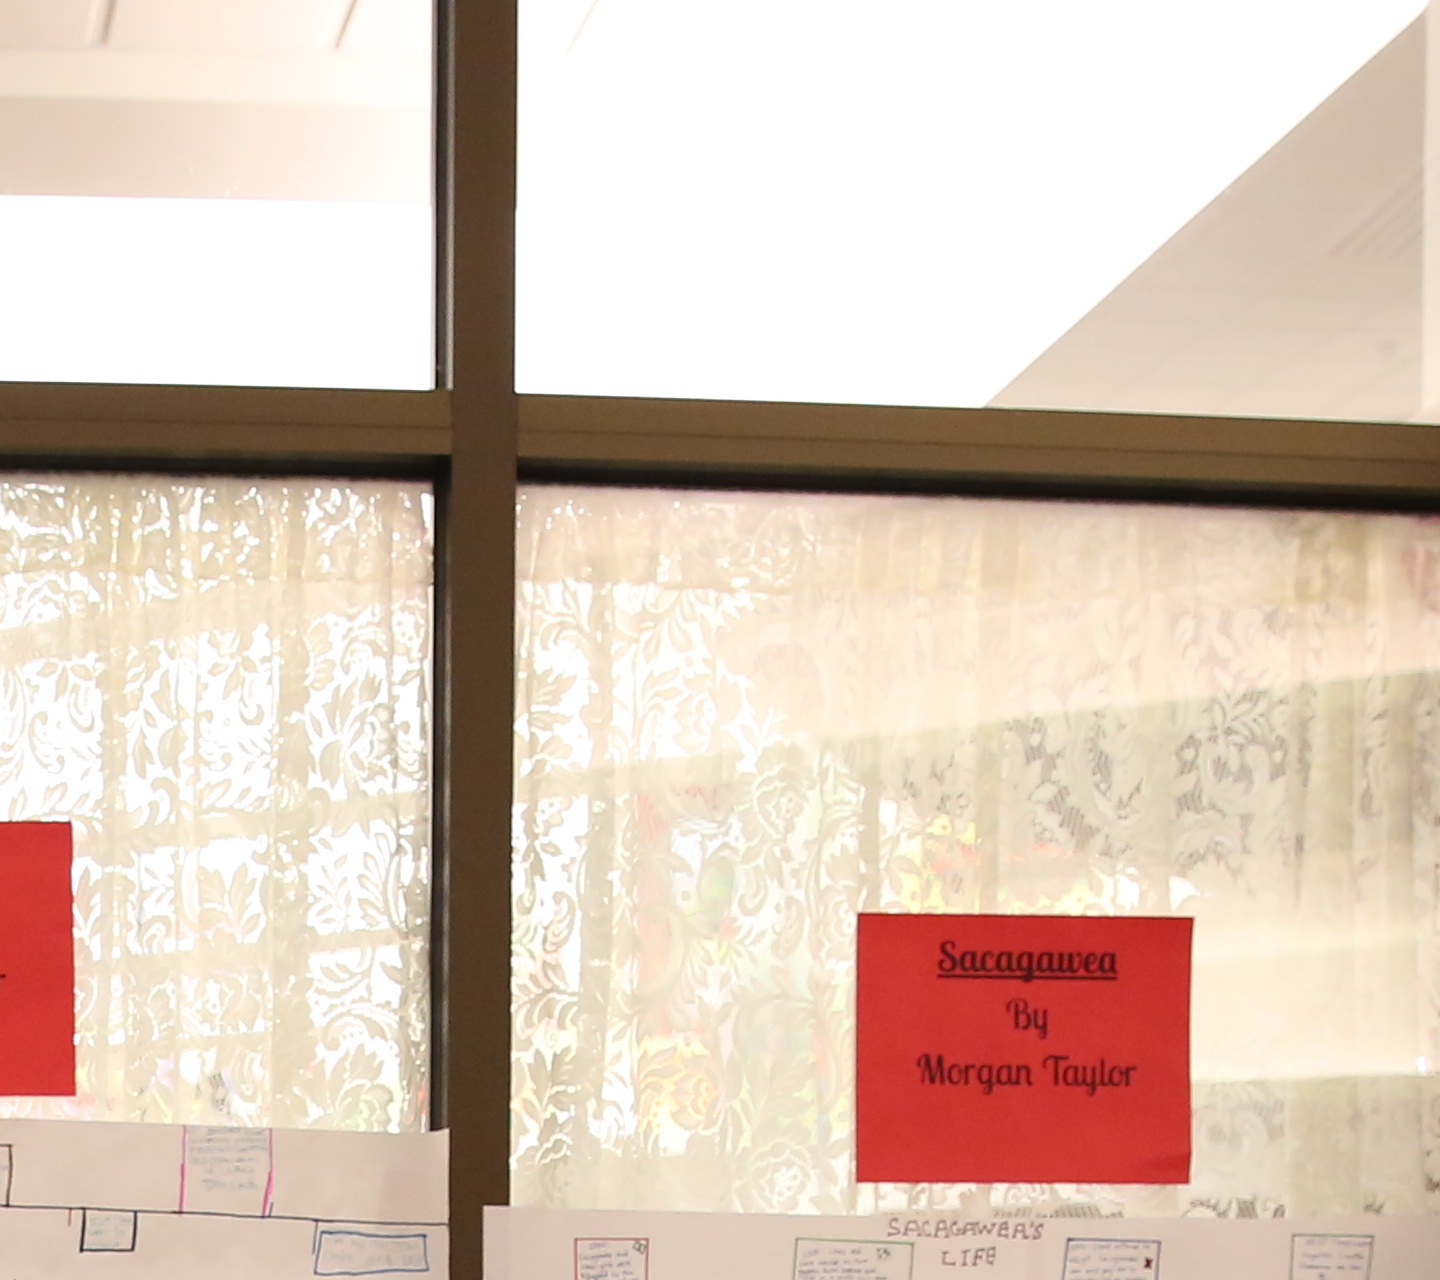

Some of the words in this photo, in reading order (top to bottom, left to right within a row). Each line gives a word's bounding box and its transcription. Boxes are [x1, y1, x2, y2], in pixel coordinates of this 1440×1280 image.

[936, 939, 1119, 983] Sacagawea
[1005, 996, 1050, 1040] By
[916, 1052, 1035, 1097] Morgan
[1041, 1053, 1138, 1098] Taylor
[940, 1245, 998, 1268] LIFE
